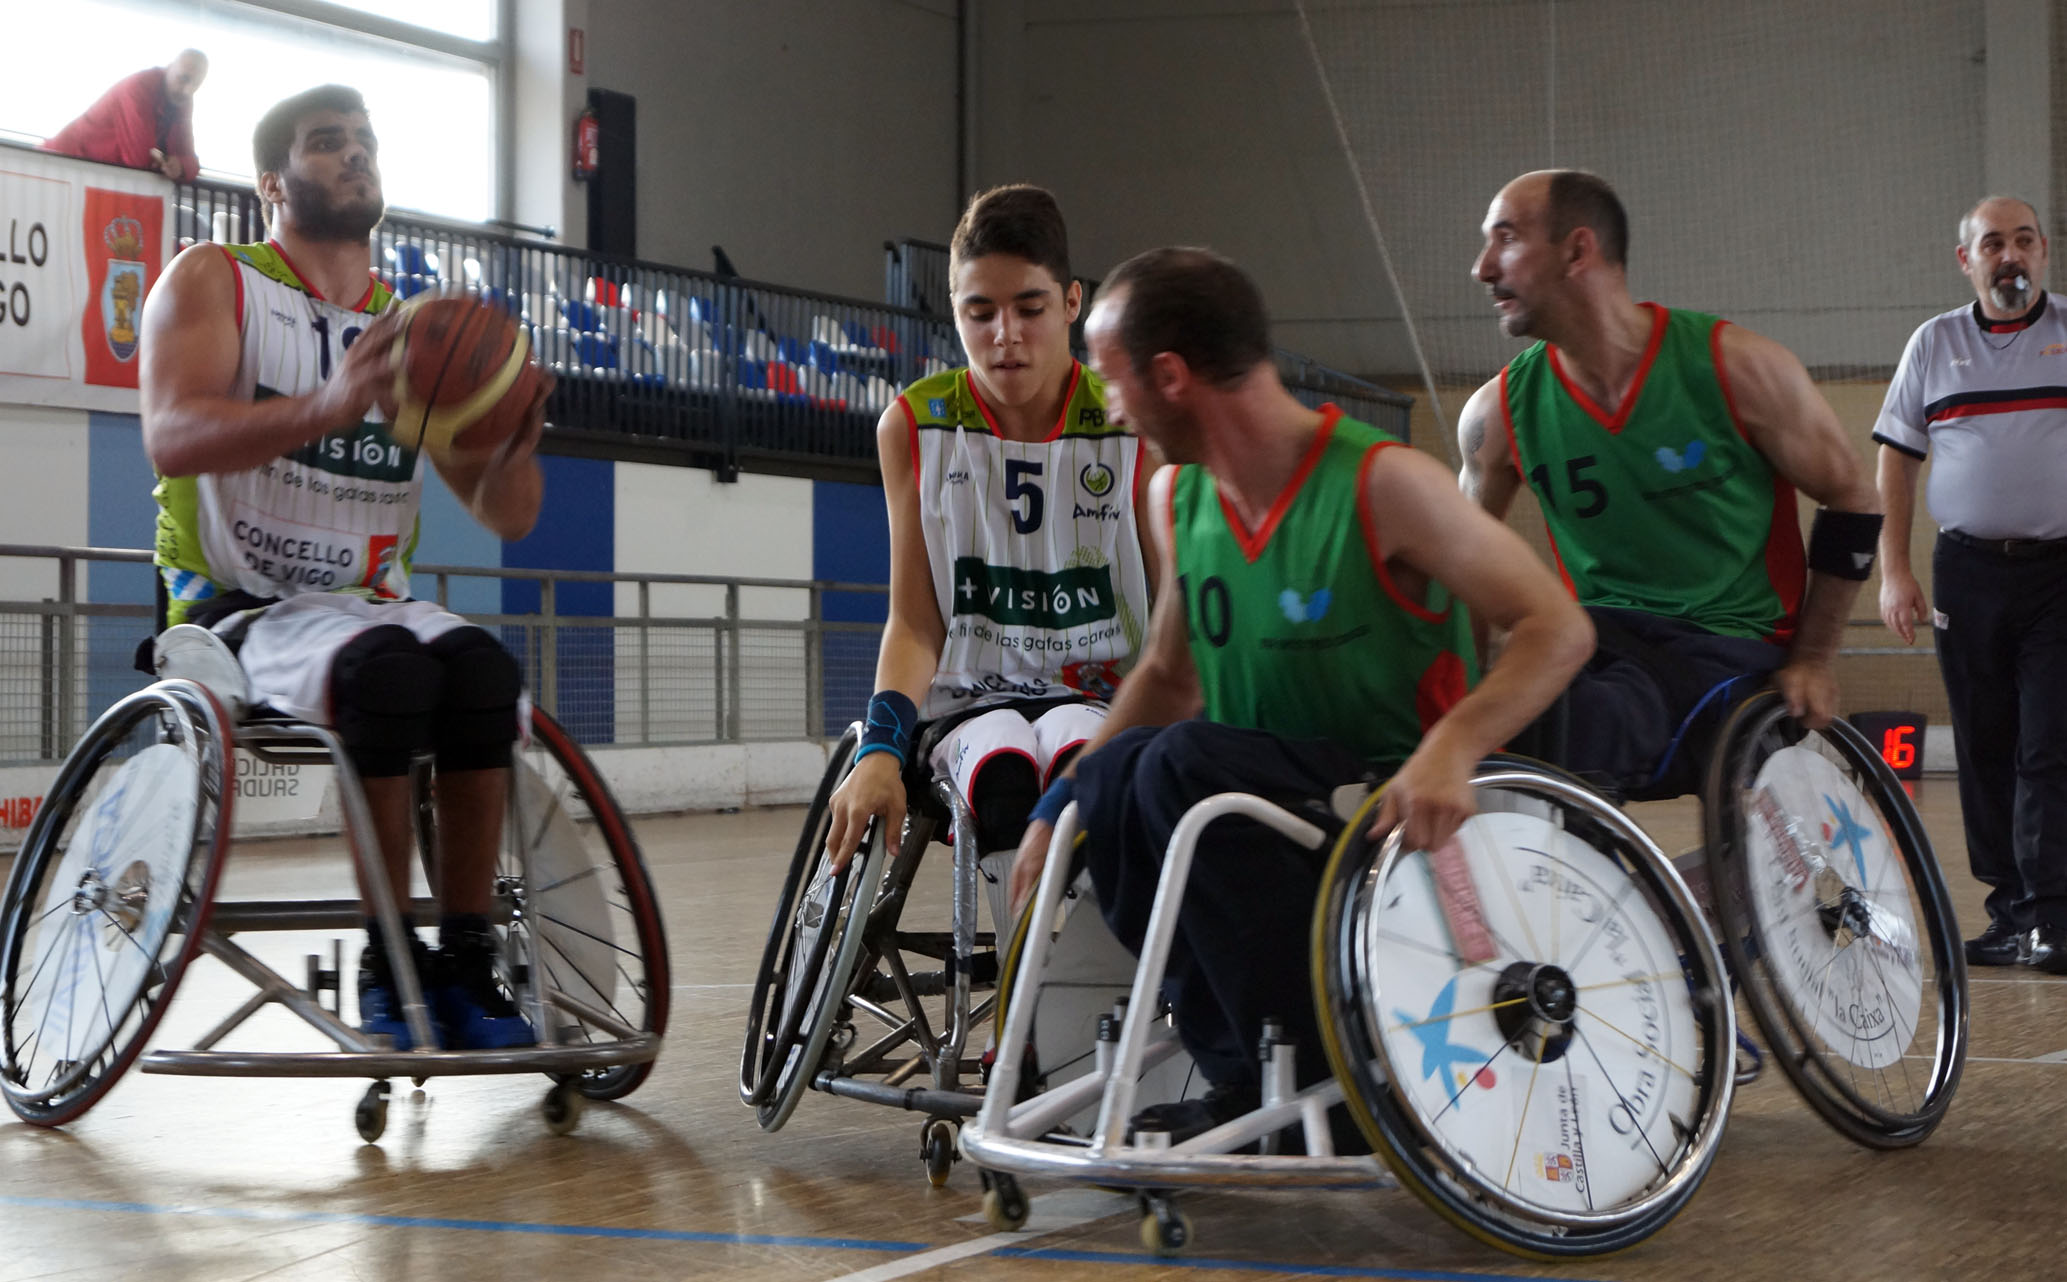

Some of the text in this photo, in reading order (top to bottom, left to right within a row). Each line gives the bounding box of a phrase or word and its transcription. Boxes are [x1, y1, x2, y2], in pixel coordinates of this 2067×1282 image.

[1005, 459, 1044, 535] 5
[1531, 454, 1609, 518] 15
[1073, 503, 1121, 521] Amfiv
[233, 520, 354, 568] CONCELLO
[243, 552, 336, 587] DE VIGO
[974, 625, 993, 641] de
[996, 631, 1019, 648] las
[1024, 636, 1073, 652] gafas
[1078, 624, 1121, 648] caras
[1557, 1085, 1571, 1150] Junta de
[1571, 1141, 1585, 1193] Castilla
